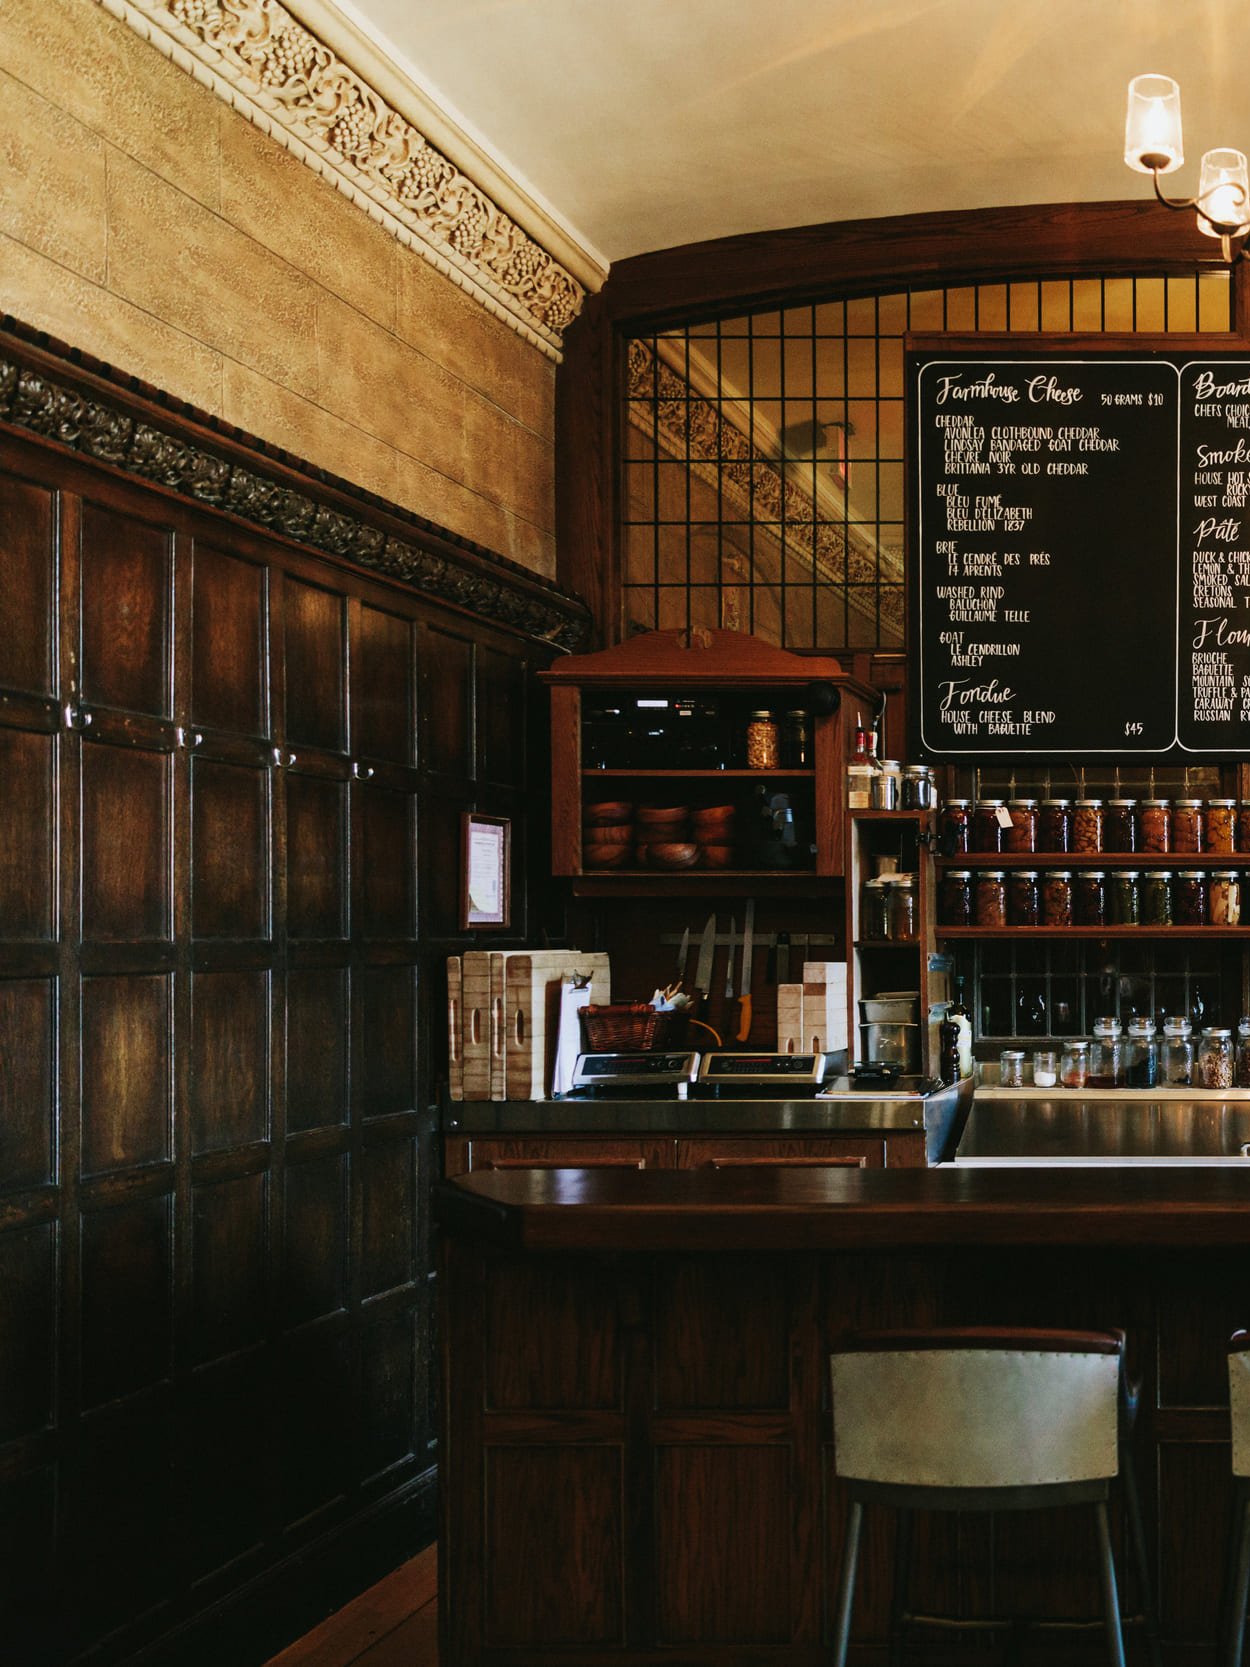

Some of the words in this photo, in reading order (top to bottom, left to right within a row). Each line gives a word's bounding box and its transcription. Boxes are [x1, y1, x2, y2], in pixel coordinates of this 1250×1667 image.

[936, 373, 1020, 405] Farmhouse
[1025, 376, 1083, 405] Cheese
[1101, 394, 1112, 406] 50
[1114, 394, 1142, 405] GRAMS
[1148, 393, 1164, 406] $10
[935, 415, 975, 427] CHEDDAR
[944, 427, 985, 439] AVONLEA
[991, 427, 1053, 439] CLOTHBOUND
[1058, 428, 1100, 439] CHEDDAR
[944, 440, 984, 451] LINDSAY
[991, 440, 1041, 451] BANDAGED
[1048, 440, 1072, 450] GOAT
[1079, 439, 1120, 451] CHEDDAR
[989, 452, 1011, 463] NOIR
[945, 463, 991, 474] BRITTANIA
[997, 464, 1016, 474] 3YR
[1022, 463, 1040, 474] OLD
[1047, 463, 1088, 475] CHEDDAR
[1195, 473, 1223, 484] HOUSE
[1228, 472, 1244, 484] HOT
[937, 484, 959, 496] BLUE
[947, 496, 969, 508] BLEU
[1195, 496, 1217, 507] WEST
[1222, 496, 1247, 507] COAST
[947, 508, 968, 520] BLEU
[947, 520, 995, 531] REBELLION
[1004, 520, 1024, 531] 1837
[936, 541, 959, 554] BRIE
[948, 554, 957, 565] LE
[1004, 554, 1020, 565] DES
[1193, 551, 1216, 563] DUCK
[1218, 553, 1226, 563] &
[963, 565, 1002, 576] APRENTS
[1193, 563, 1221, 575] LEMON
[1227, 564, 1235, 575] &
[1193, 575, 1227, 586] SMOKED
[937, 586, 975, 599] WASHED
[980, 586, 1004, 599] RIND
[1193, 586, 1232, 597] CRETONS
[950, 599, 996, 610] BALUCHON
[1193, 597, 1237, 608] SEASONAL
[949, 611, 997, 622] GUILLAUME
[1004, 611, 1030, 622] TELLE
[939, 632, 964, 643] GOAT
[951, 644, 961, 655] LE
[968, 644, 1020, 655] CENDRILLON
[951, 656, 983, 666] ASHLEY
[1192, 653, 1228, 664] BRIOCHE
[1193, 664, 1234, 675] BAGUETTE
[1192, 676, 1234, 686] MOUNTAIN
[938, 678, 1016, 710] Fondue
[1193, 687, 1227, 698] TRUFFLE
[1231, 687, 1238, 698] &
[1195, 699, 1234, 709] CARAWAY
[941, 711, 971, 723] HOUSE
[979, 711, 1013, 723] CHEESE
[1024, 711, 1056, 723] BLEND
[1194, 710, 1231, 721] RUSSIAN
[954, 724, 977, 735] WITH
[988, 724, 1031, 735] BAGUETTE
[1125, 722, 1143, 736] $45
